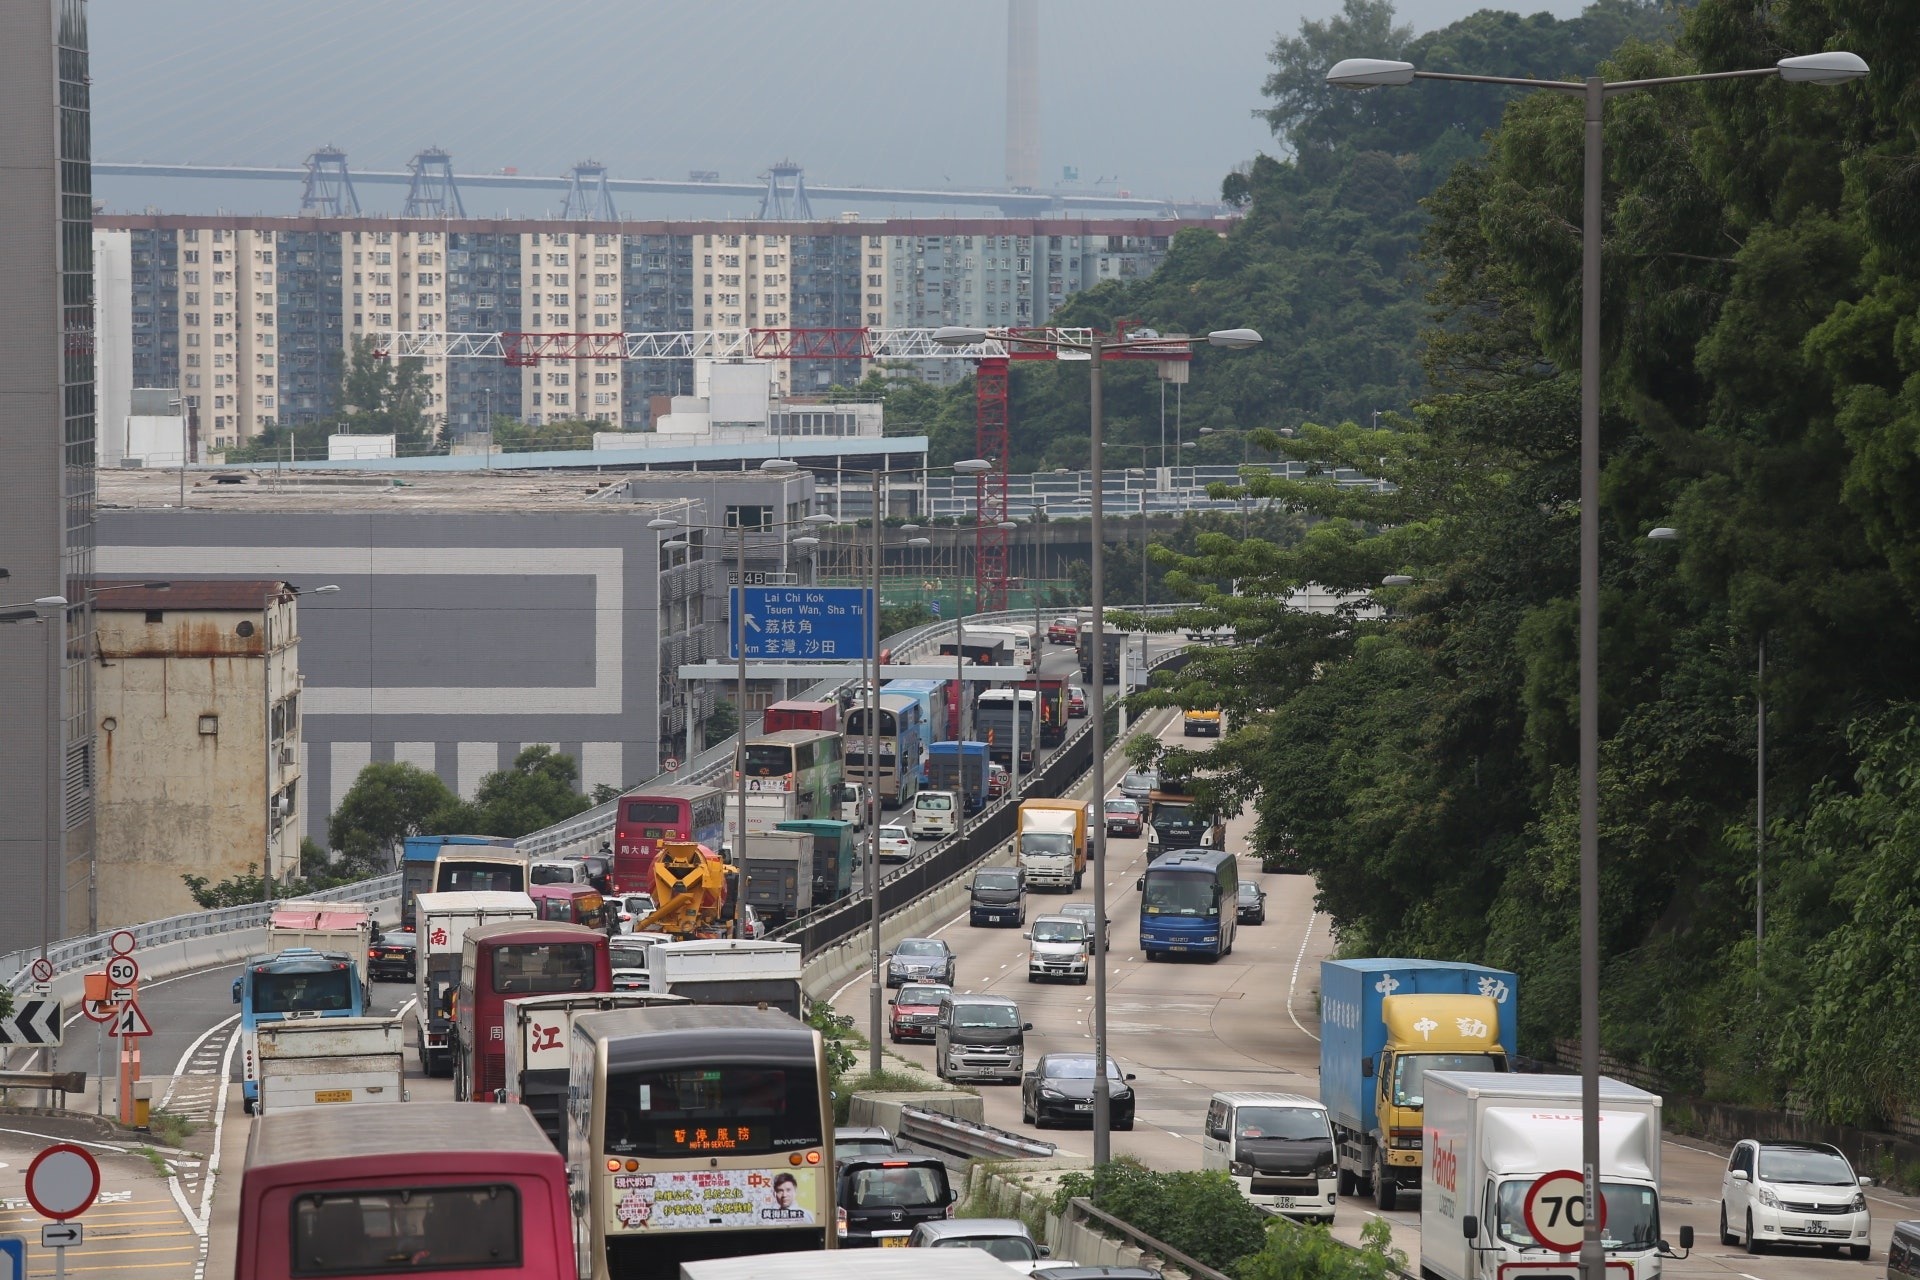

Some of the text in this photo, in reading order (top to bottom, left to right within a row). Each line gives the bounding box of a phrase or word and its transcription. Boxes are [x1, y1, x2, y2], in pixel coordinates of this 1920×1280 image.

[744, 573, 764, 584] 4B
[764, 592, 824, 603] Lai Chi Kok
[765, 605, 793, 615] Tsuen
[799, 605, 822, 616] Wan,
[827, 605, 845, 615] Sha
[765, 619, 812, 634] 荔枝角
[745, 644, 759, 653] km
[621, 845, 650, 855] 周大福
[430, 927, 447, 946] 南
[112, 965, 133, 980] 50
[489, 1026, 504, 1041] 周
[532, 1023, 564, 1053] 江
[674, 1127, 750, 1144] 暫停服務
[689, 1141, 701, 1149] NOT
[711, 1139, 736, 1148] SERVICE
[1432, 1131, 1457, 1193] Panda
[747, 1173, 772, 1188] 中文
[1541, 1195, 1585, 1228] 70
[1807, 1226, 1828, 1234] 2272
